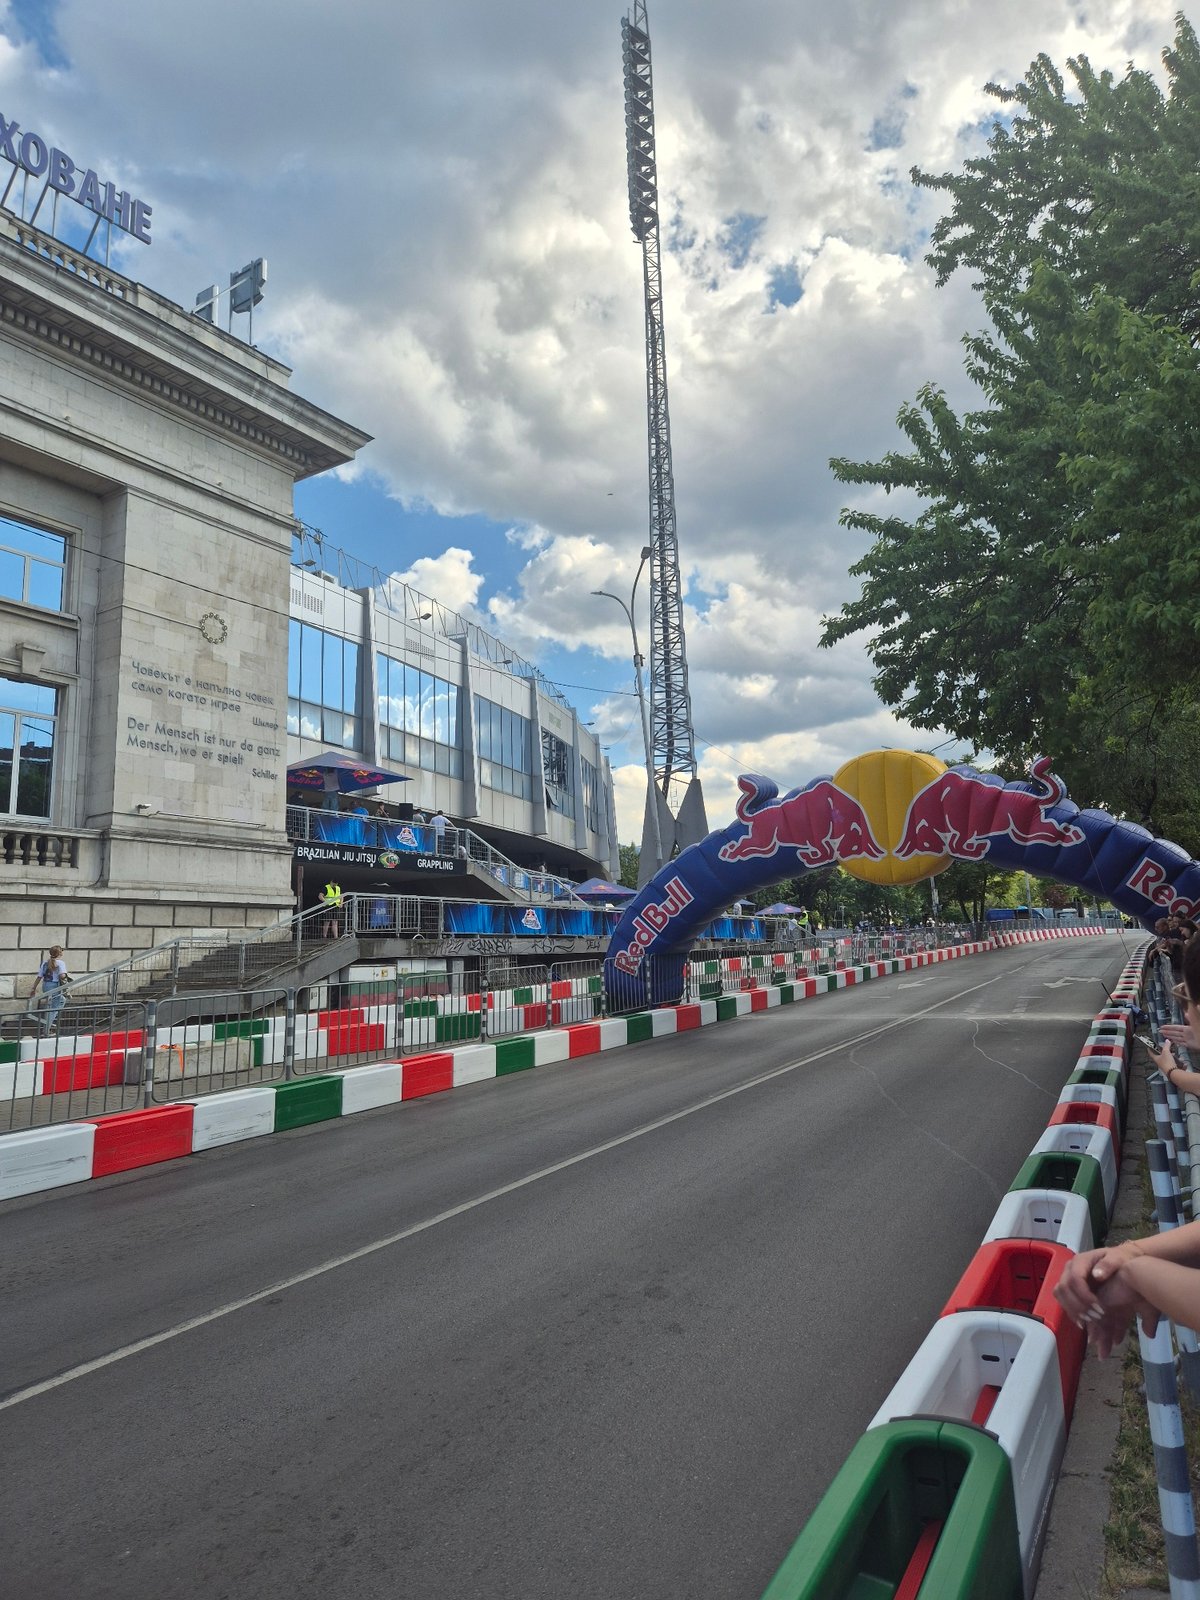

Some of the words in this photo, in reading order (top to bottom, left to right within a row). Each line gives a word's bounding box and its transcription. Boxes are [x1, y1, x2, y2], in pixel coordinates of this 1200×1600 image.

[131, 681, 163, 696] само
[168, 688, 207, 705] когато
[210, 699, 241, 713] играе
[132, 660, 181, 683] Човекът
[184, 677, 192, 686] е
[195, 680, 241, 697] напълно
[245, 691, 275, 705] човек
[127, 716, 150, 732] Der
[155, 721, 200, 742] Mensch
[204, 731, 216, 745] ist
[219, 737, 236, 748] nur
[240, 738, 253, 752] da
[257, 744, 281, 758] ganz
[252, 716, 279, 731] Шилер
[126, 734, 178, 757] Mensch,
[180, 745, 197, 757] wo
[201, 749, 213, 760] er
[217, 751, 244, 765] spielt
[251, 767, 279, 781] Schiller
[297, 846, 340, 861] BRAZILIAN
[342, 852, 355, 863] JIU
[355, 852, 377, 864] JITSU
[417, 858, 454, 871] GRAPPLING
[614, 916, 658, 977] Red
[641, 875, 695, 933] Bull
